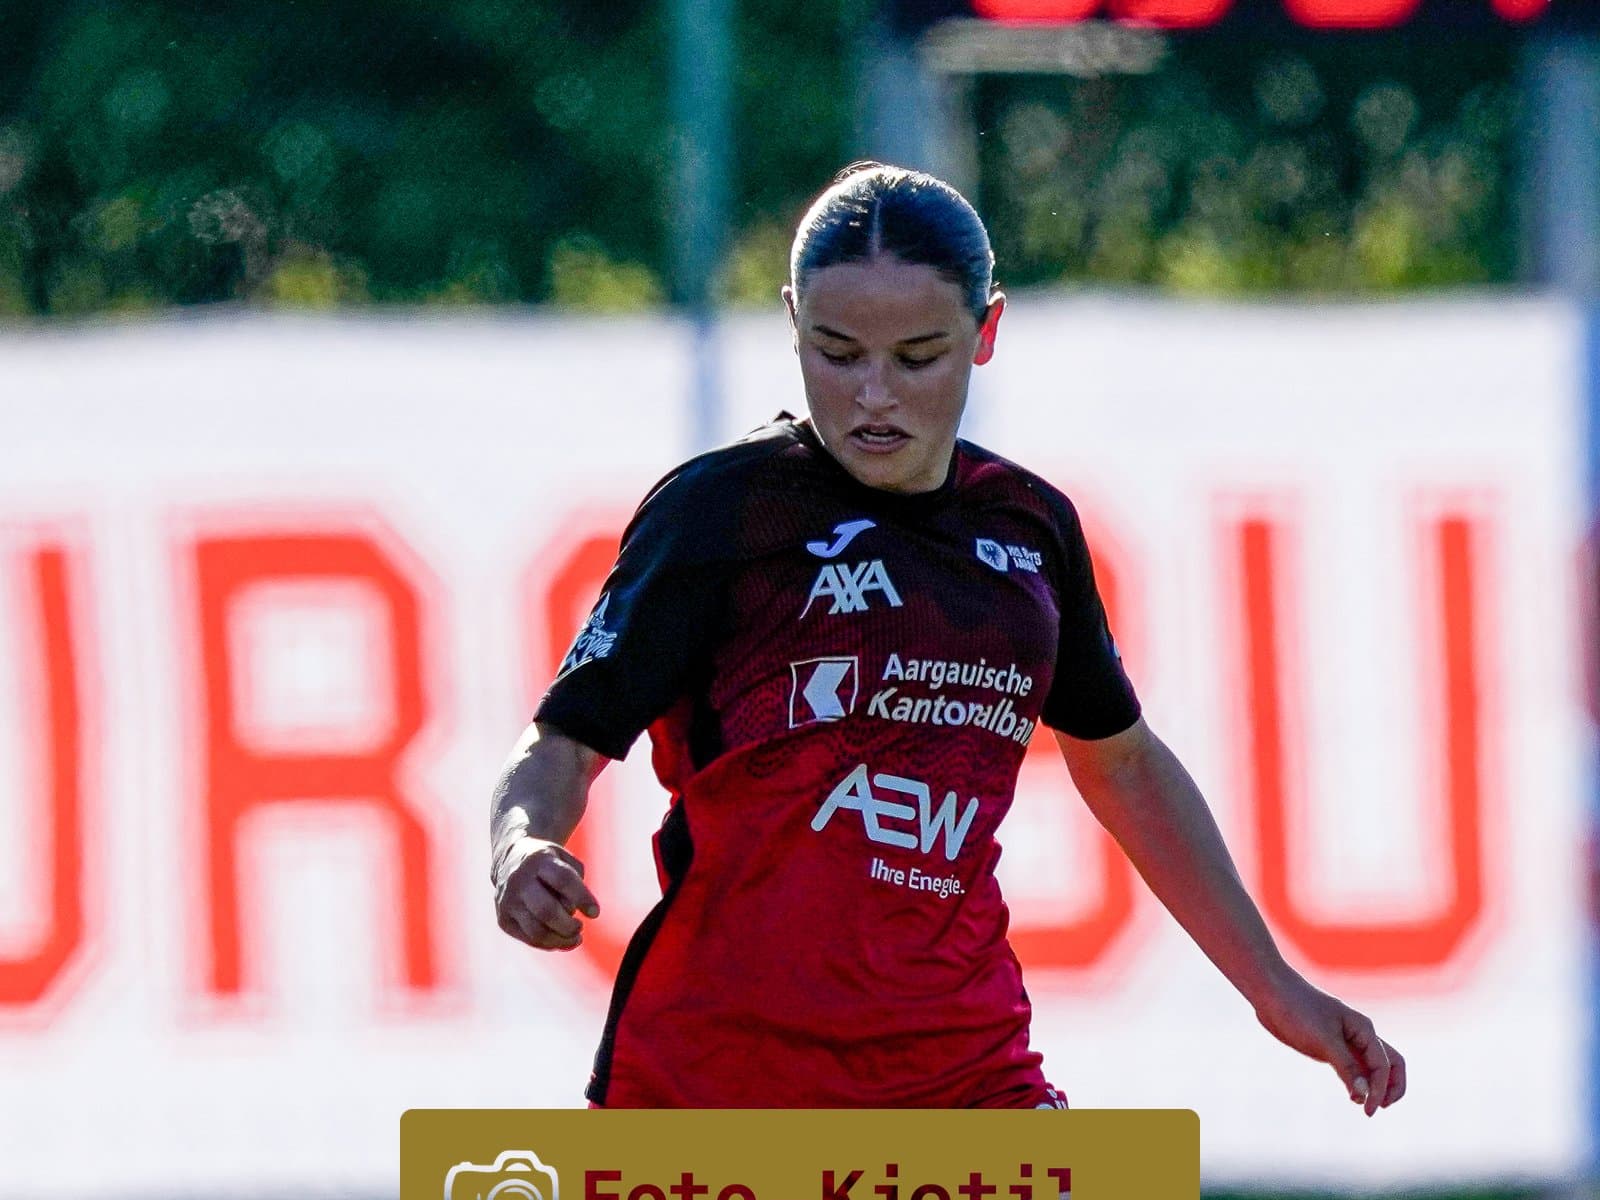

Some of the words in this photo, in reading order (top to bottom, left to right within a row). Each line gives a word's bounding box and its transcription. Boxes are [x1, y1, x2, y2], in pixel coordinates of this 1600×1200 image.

[799, 559, 904, 620] AXA
[881, 652, 1033, 697] Aargauische
[810, 763, 980, 861] AEW
[870, 857, 905, 885] Ihre
